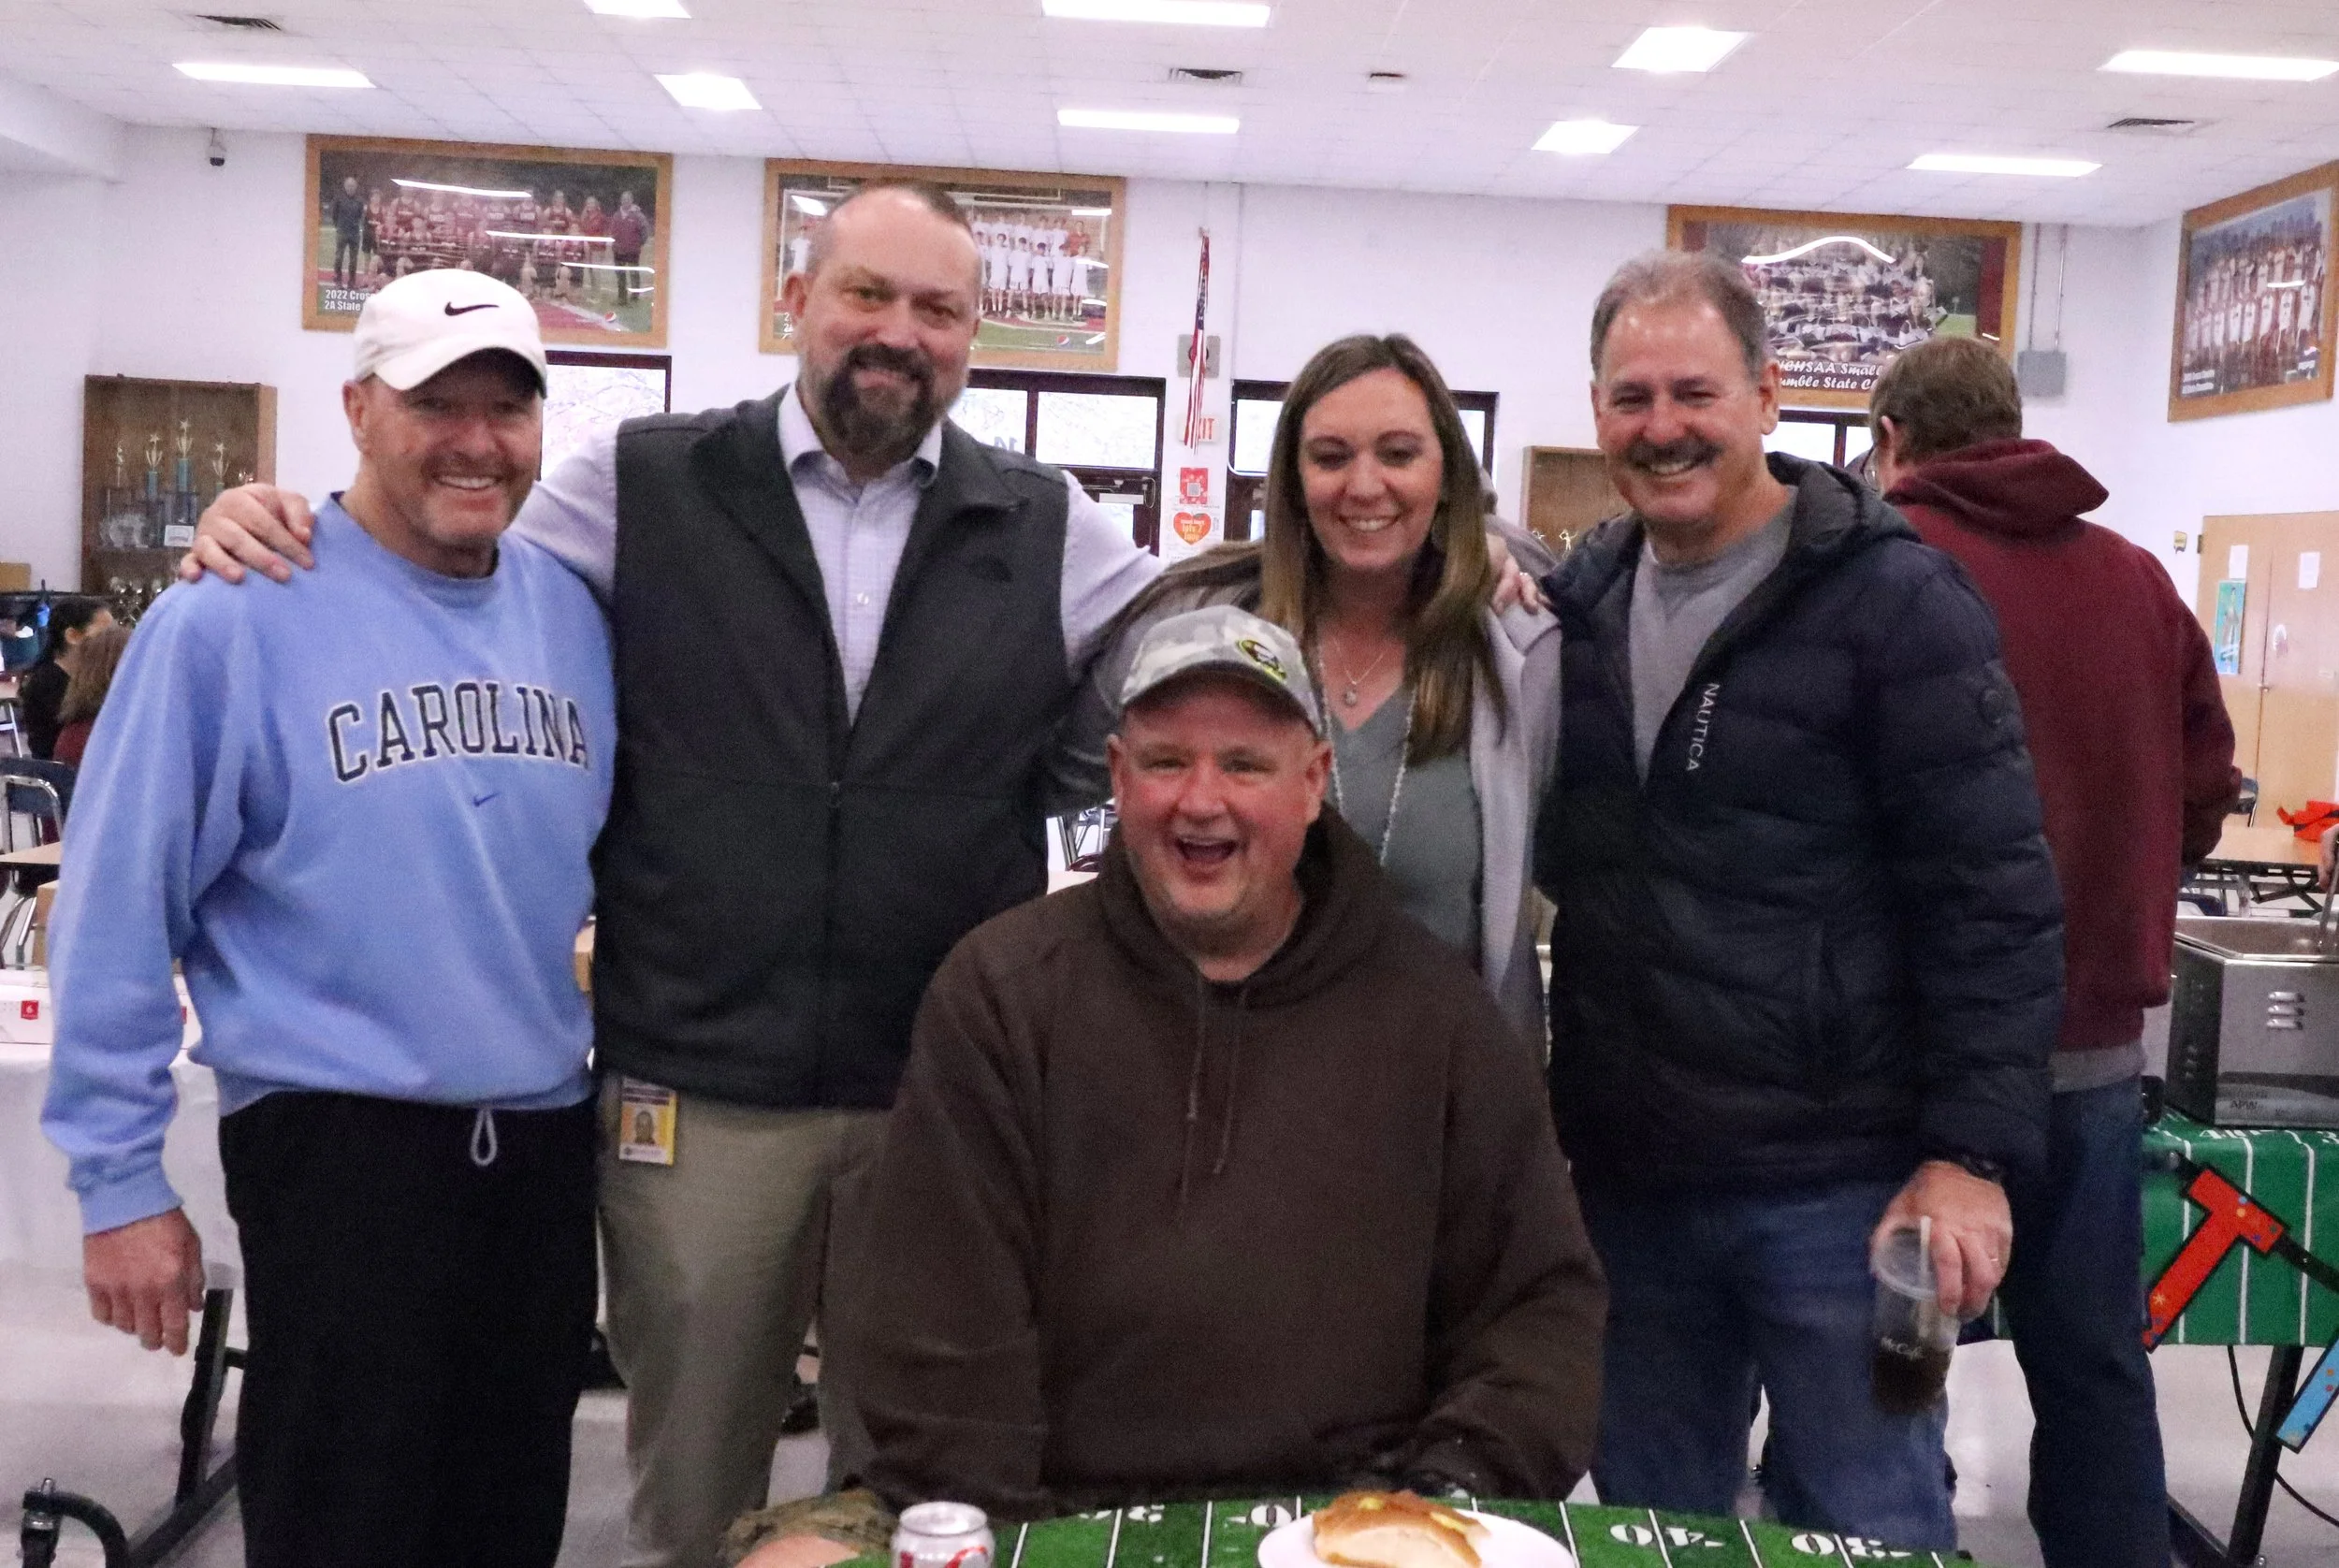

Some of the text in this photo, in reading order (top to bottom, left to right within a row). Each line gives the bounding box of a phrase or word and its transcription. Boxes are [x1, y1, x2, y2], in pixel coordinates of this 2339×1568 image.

[326, 289, 348, 300] 2022
[324, 300, 361, 312] 2A State
[1840, 363, 1883, 377] Small
[1780, 375, 1820, 388] umble
[1823, 376, 1857, 390] State
[327, 681, 590, 783] CAROLINA
[1686, 682, 1721, 772] NAUTICA
